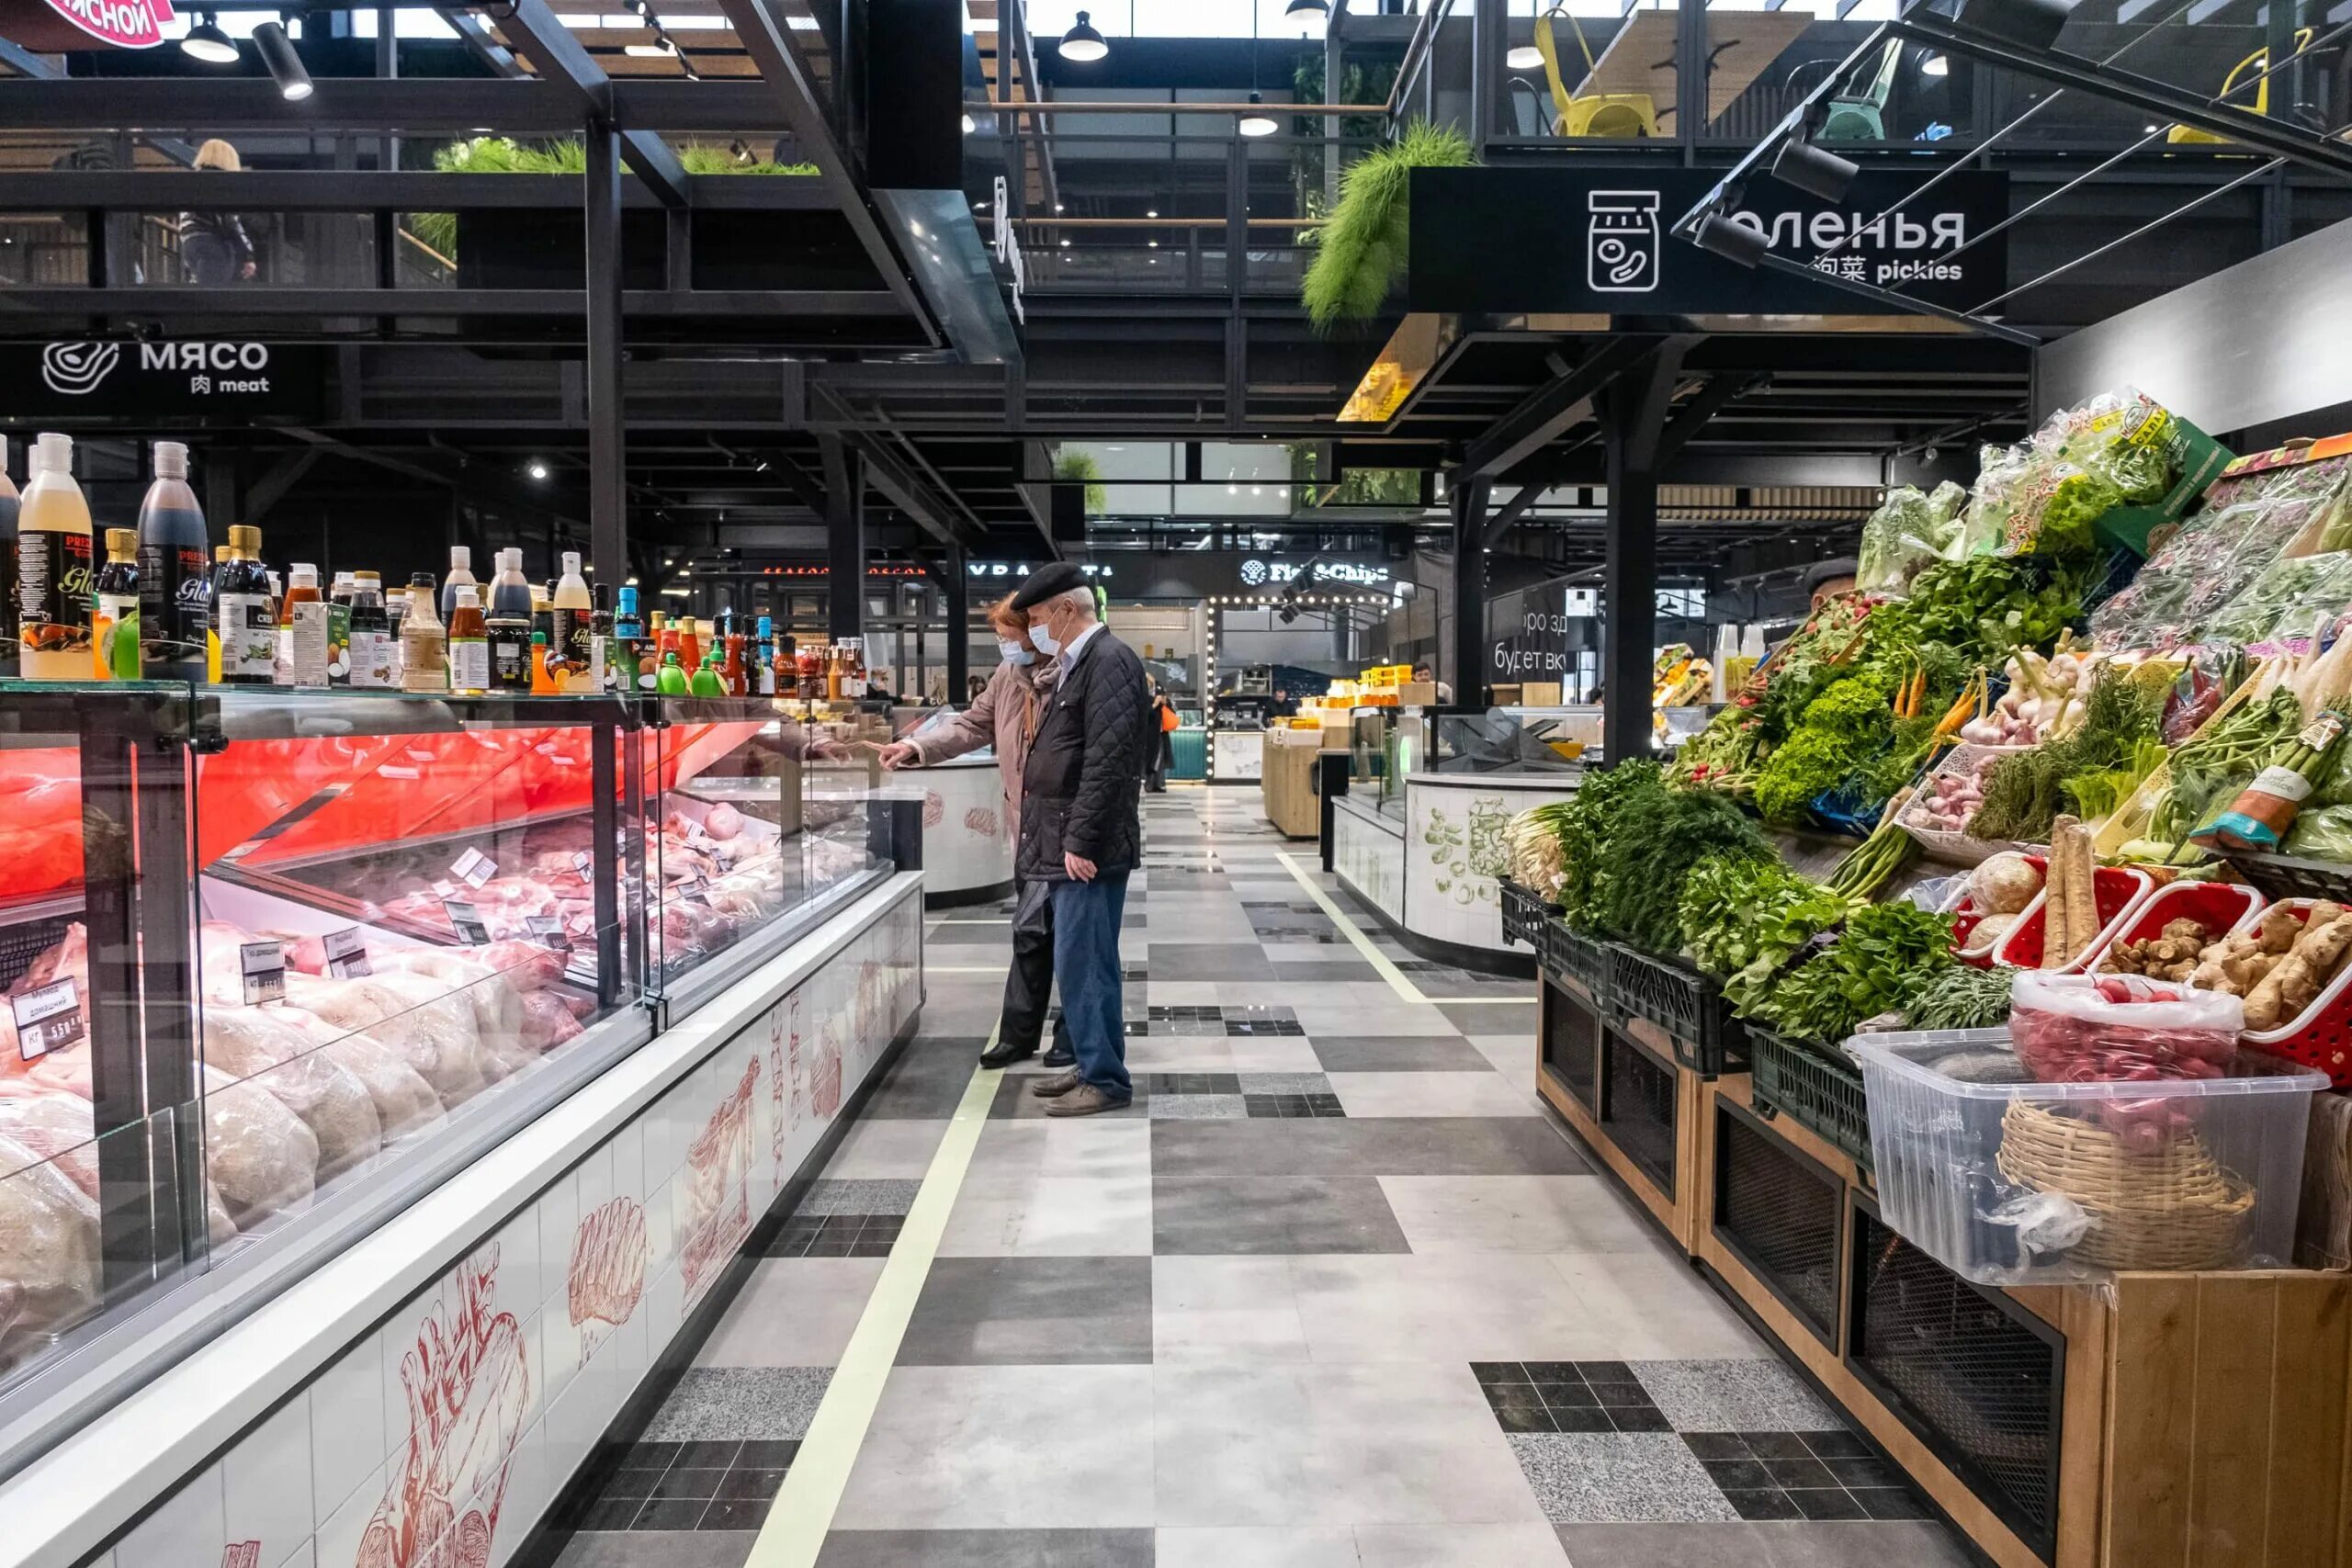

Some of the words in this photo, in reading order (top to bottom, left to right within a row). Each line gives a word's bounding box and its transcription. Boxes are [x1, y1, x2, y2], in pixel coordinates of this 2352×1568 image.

[58, 0, 153, 35] ЯСНОЙ
[1687, 211, 1964, 249] оленья
[191, 375, 210, 394] 肉
[220, 378, 270, 392] meat
